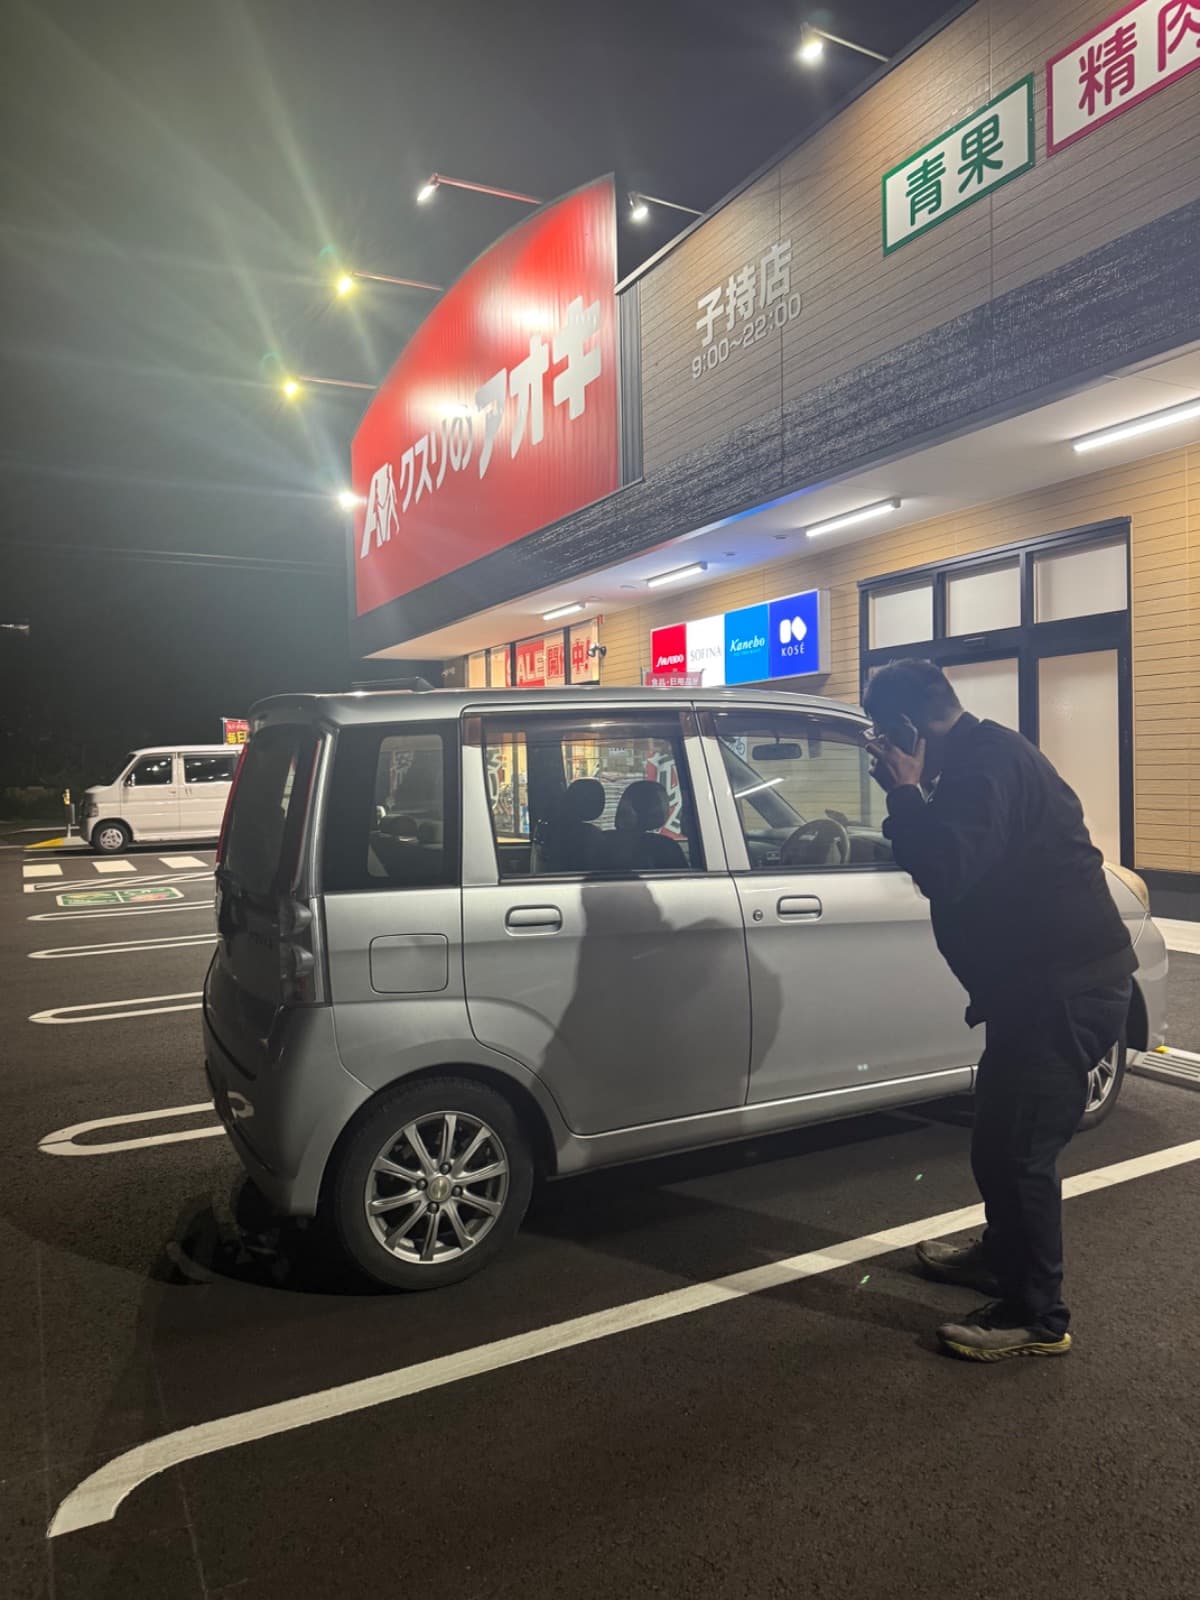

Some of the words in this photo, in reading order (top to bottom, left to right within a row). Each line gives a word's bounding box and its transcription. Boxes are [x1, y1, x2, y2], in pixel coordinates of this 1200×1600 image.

[905, 114, 1004, 226] 青果
[692, 292, 802, 379] 9:00~22:00
[696, 239, 792, 348] 子持店
[399, 295, 602, 513] クスリのアオキ
[690, 645, 722, 662] SOFINA
[729, 634, 766, 653] Kanebo
[781, 641, 805, 657] KOSÉ
